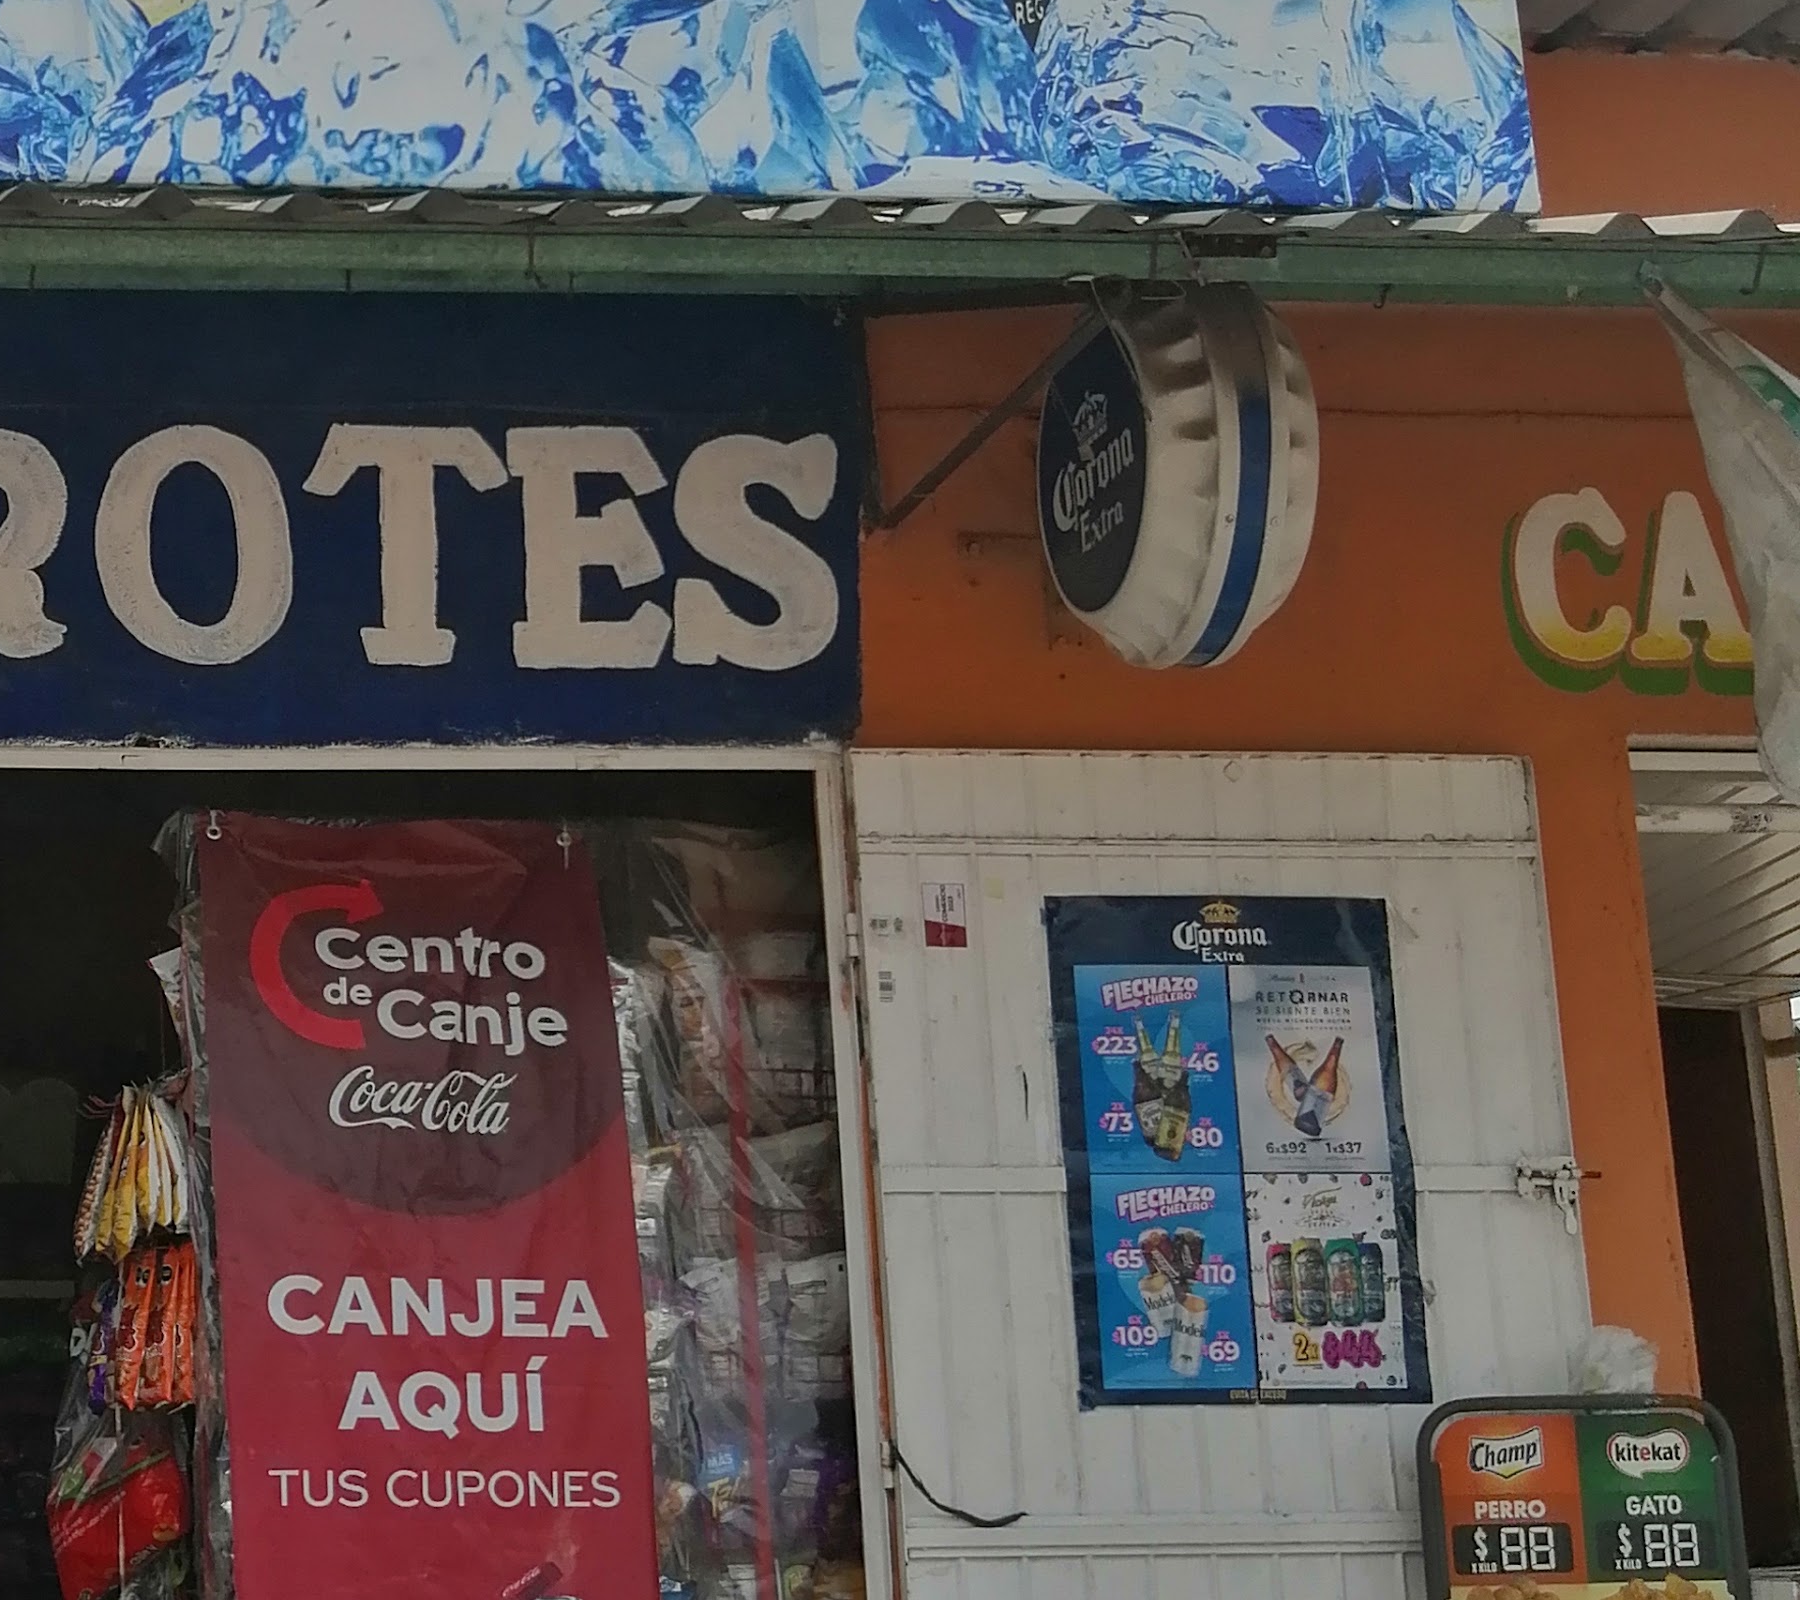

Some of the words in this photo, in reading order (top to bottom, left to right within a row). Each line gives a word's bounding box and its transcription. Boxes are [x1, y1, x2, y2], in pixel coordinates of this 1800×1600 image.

[1052, 427, 1135, 533] Corona
[1078, 501, 1124, 553] Extra
[314, 926, 546, 980] Centro
[1172, 920, 1269, 954] Corona
[1201, 949, 1245, 964] Extra
[1102, 976, 1198, 1009] FLECHAZO
[323, 977, 372, 1006] de
[377, 989, 568, 1057] Canje
[329, 1065, 518, 1135] Coca-Cola
[1117, 1186, 1215, 1221] FLECHAZO
[267, 1274, 609, 1339] CANJEA
[338, 1355, 548, 1439] AQUÍ
[1470, 1442, 1538, 1472] Champ
[1615, 1440, 1681, 1463] kitekat
[268, 1469, 369, 1508] TUS
[385, 1469, 621, 1508] CUPONES
[1625, 1495, 1682, 1516] GATO
[1475, 1500, 1546, 1520] PERRO
